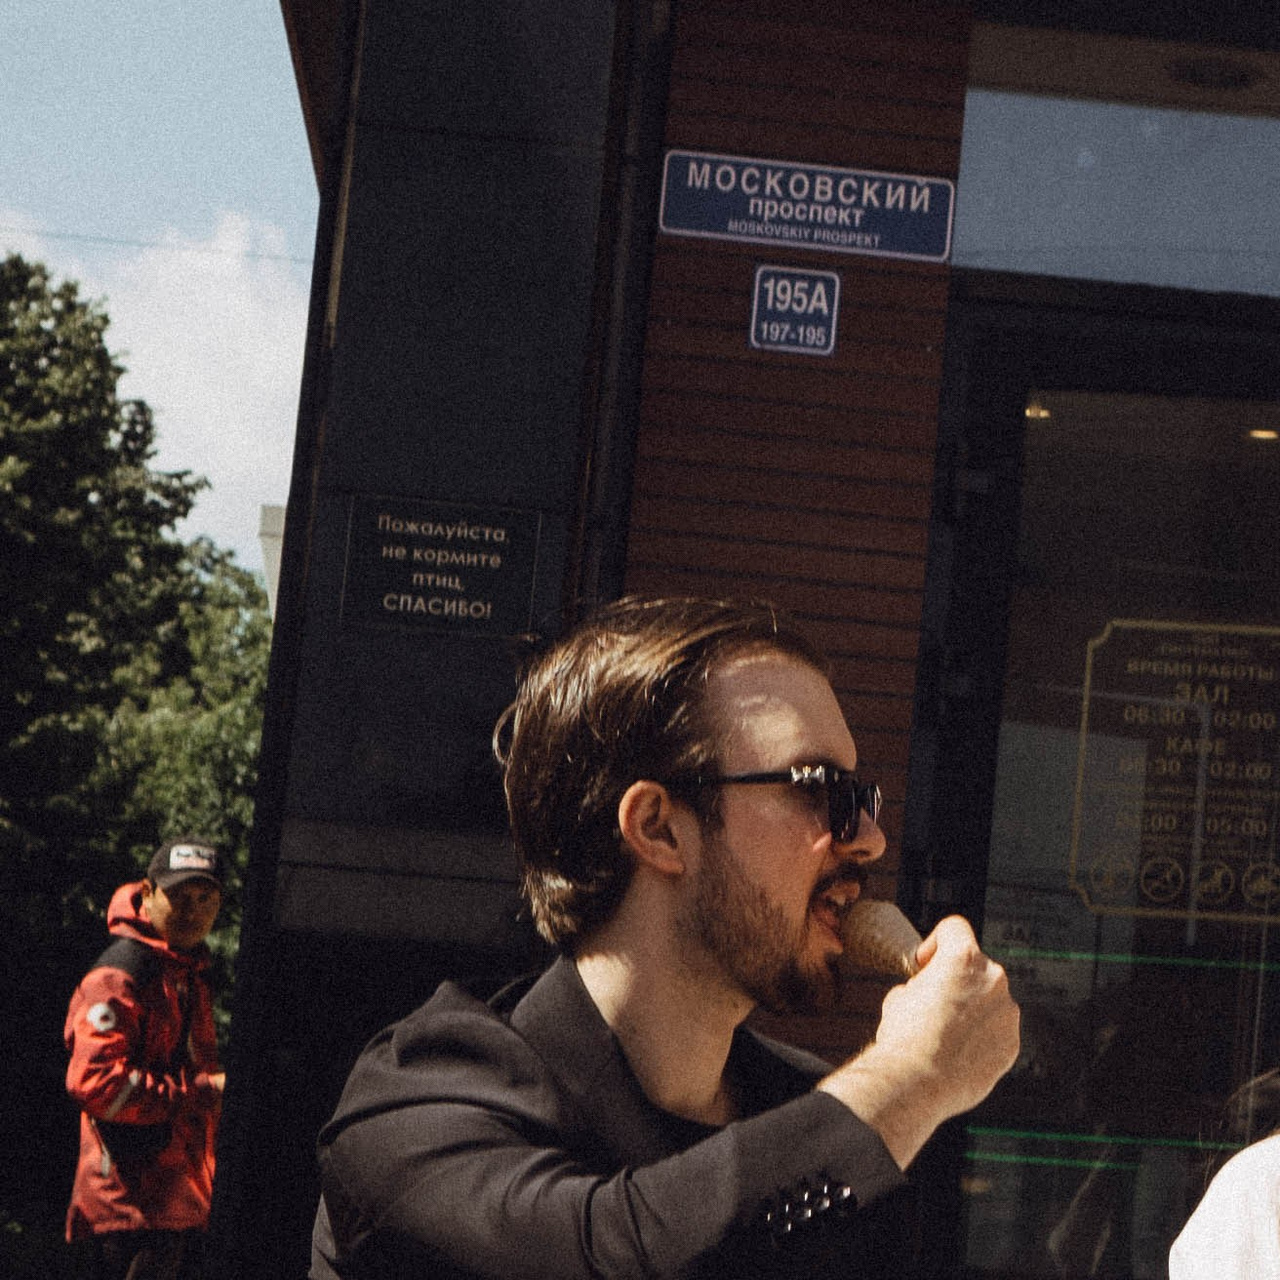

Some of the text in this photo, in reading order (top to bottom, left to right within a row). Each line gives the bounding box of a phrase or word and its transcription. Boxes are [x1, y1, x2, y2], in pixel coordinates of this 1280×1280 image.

[687, 160, 931, 213] МОСКОВСКИЙ
[748, 197, 866, 228] проспект
[727, 218, 881, 248] MOSKOVSKIY PROSPEKT
[760, 321, 827, 348] 197-195
[377, 513, 511, 544] Пожалуйста,
[381, 545, 502, 569] не кормите
[382, 592, 493, 620] СПАСИБО!
[1173, 682, 1230, 705] ЗАЛ
